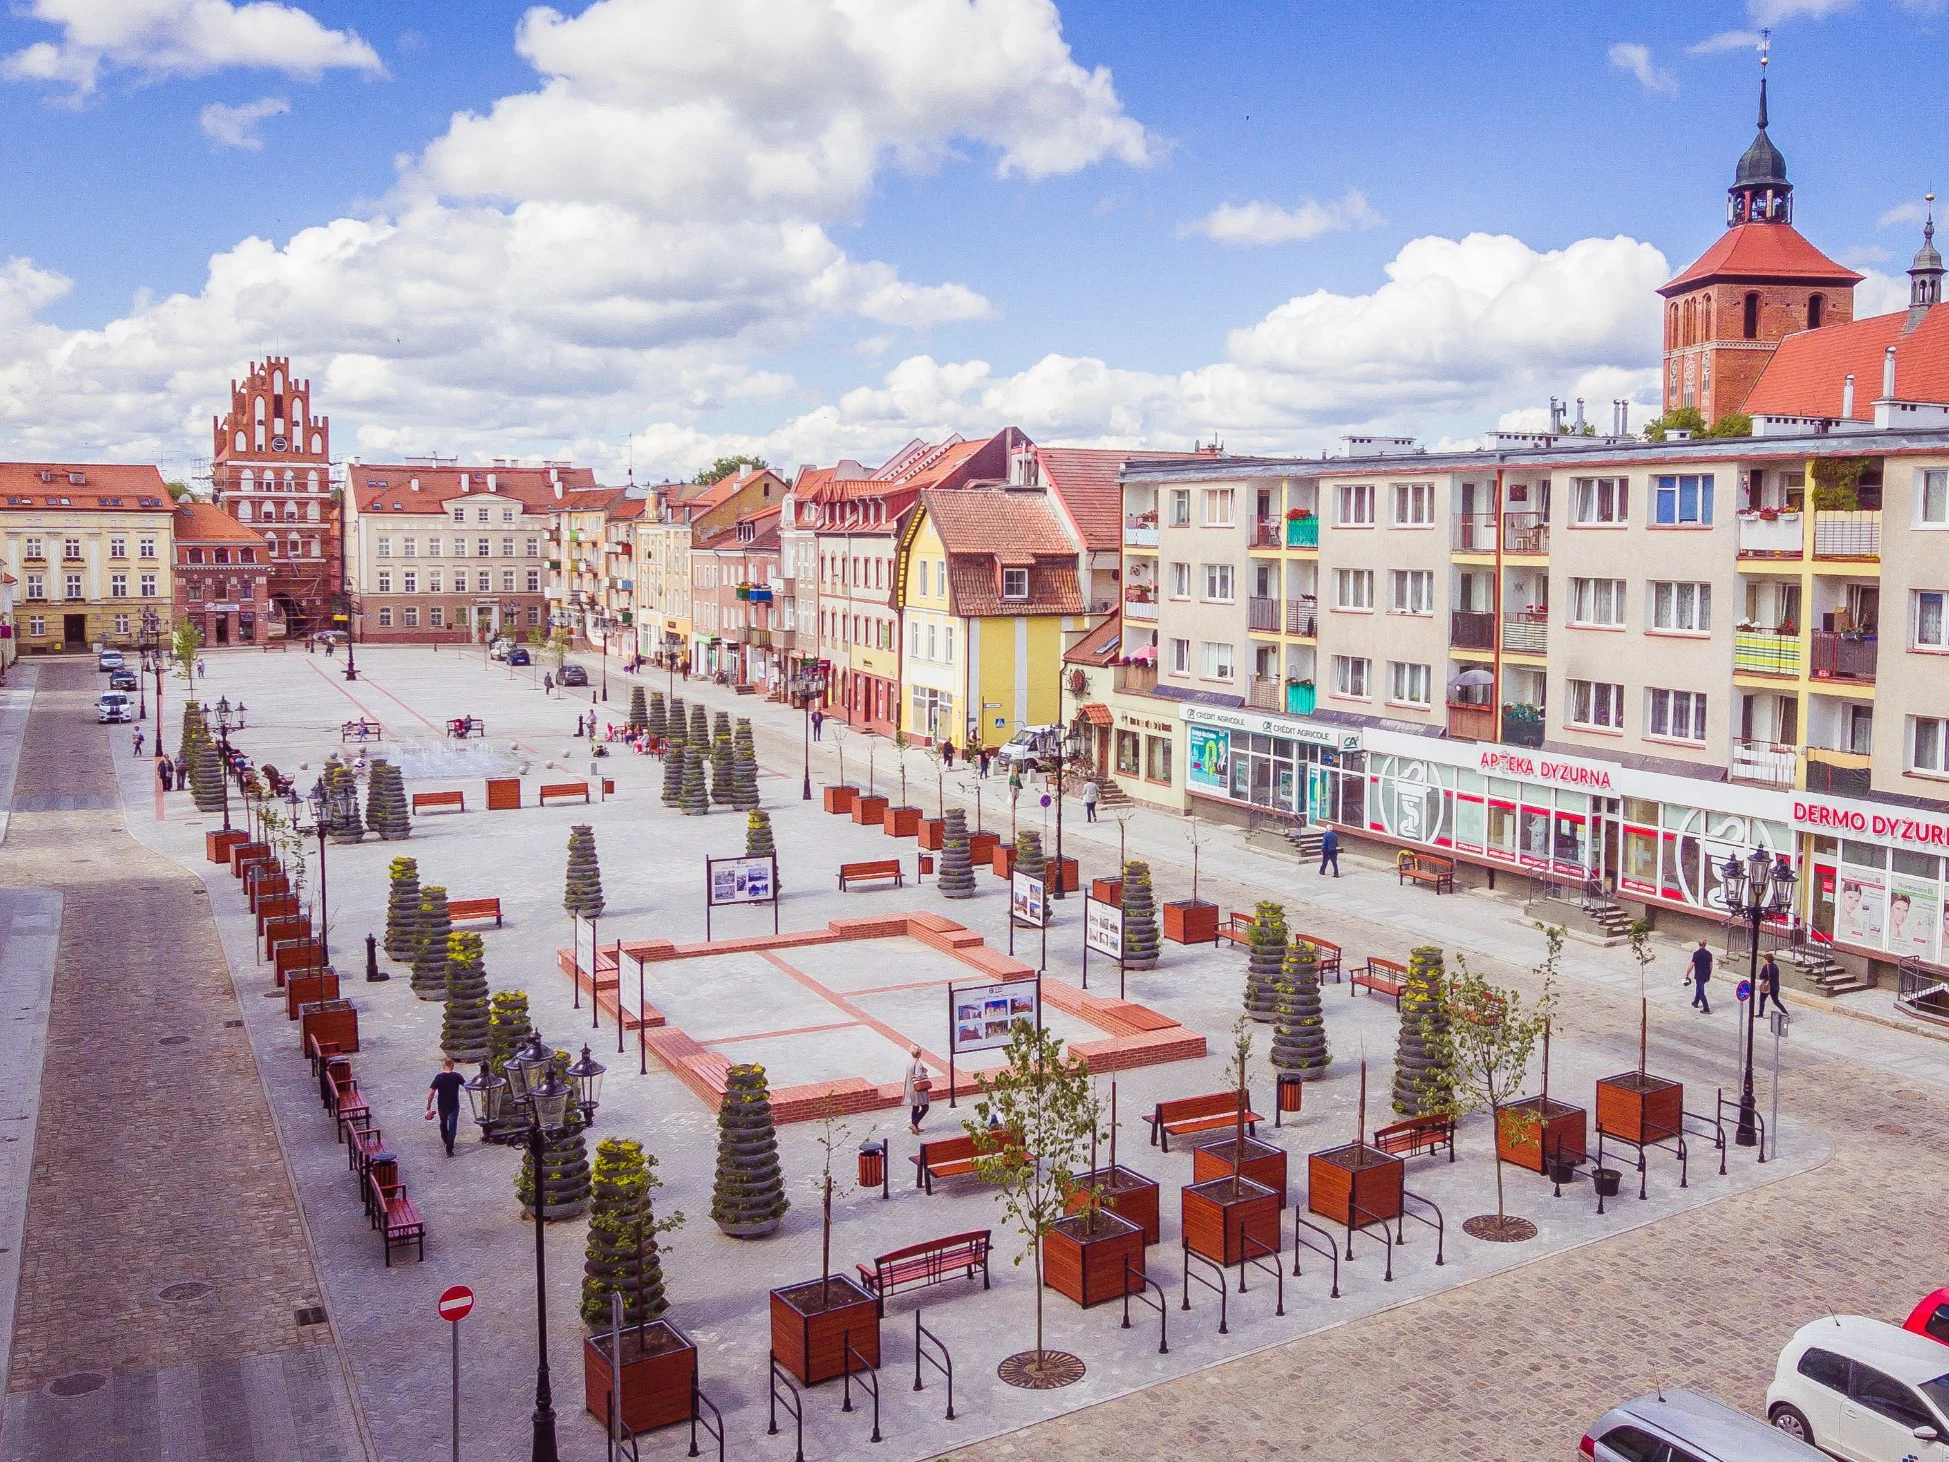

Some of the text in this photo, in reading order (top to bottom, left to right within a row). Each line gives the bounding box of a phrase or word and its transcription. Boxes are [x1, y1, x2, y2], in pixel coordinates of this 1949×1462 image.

[1217, 715, 1245, 726] AGRICOLE
[1273, 724, 1296, 735] CRÉDIT
[1297, 729, 1330, 741] AGRICOLE
[1540, 761, 1612, 788] DYŻURNA
[1793, 801, 1866, 831] DERMO
